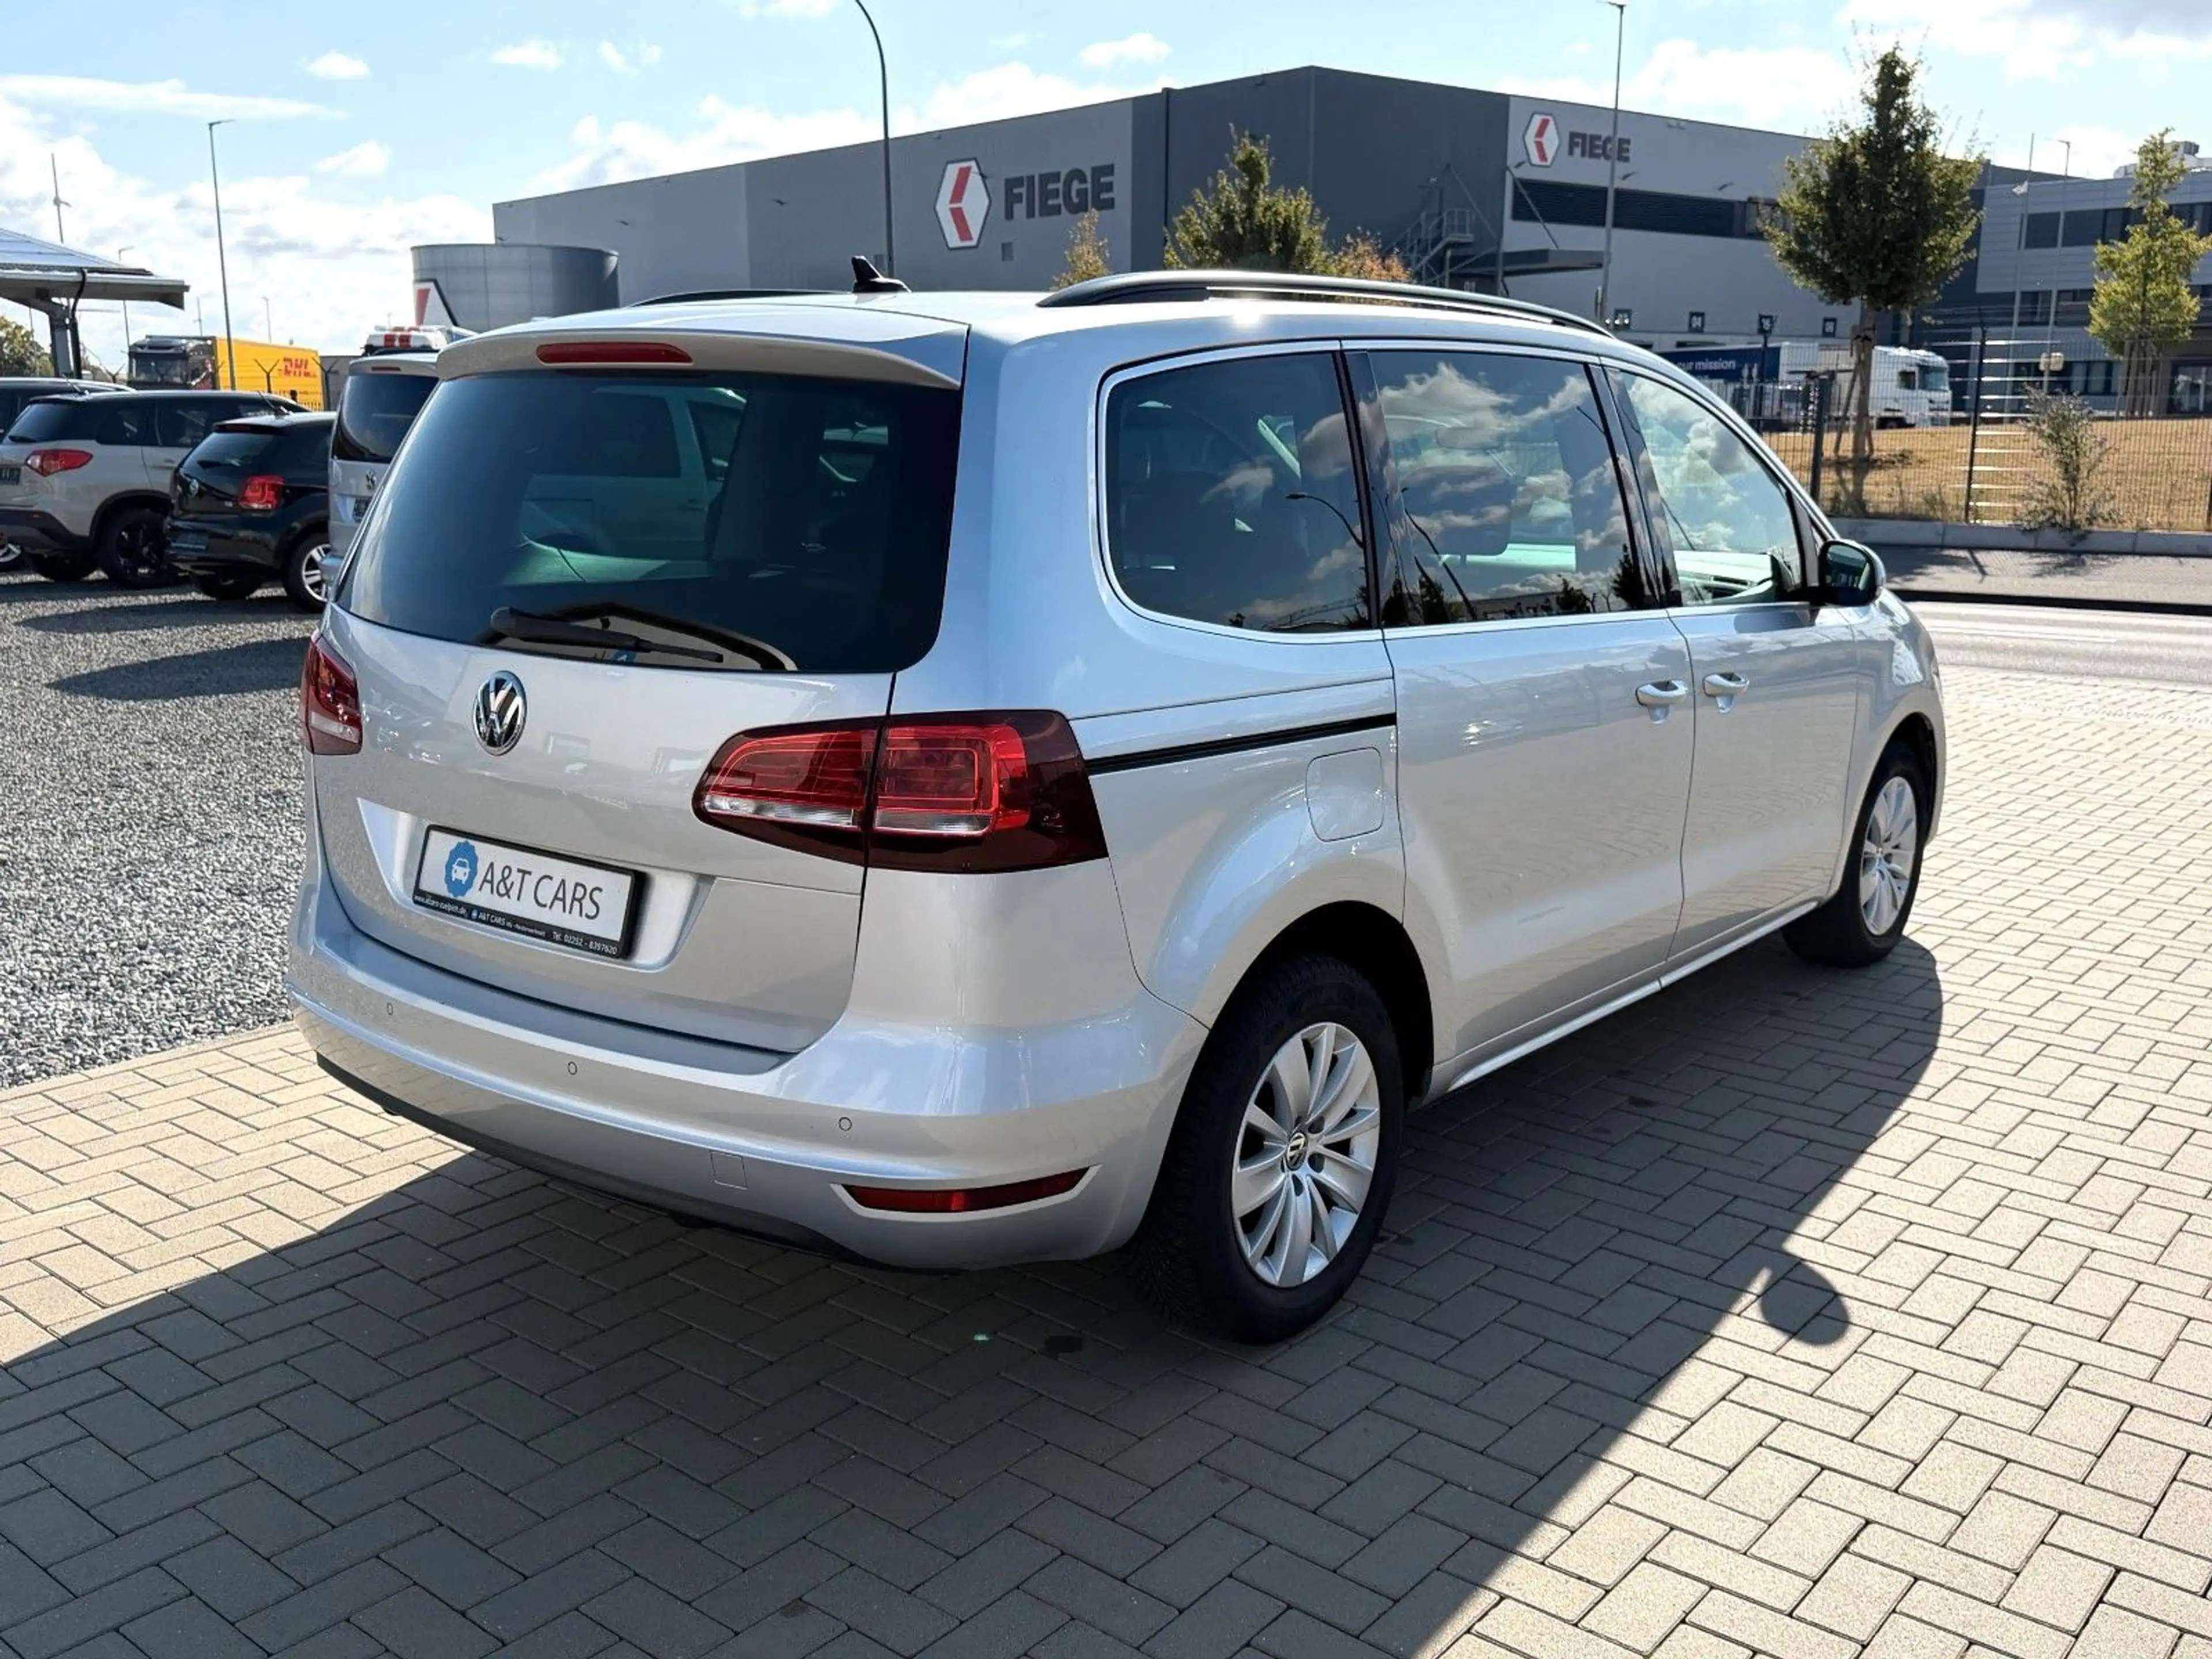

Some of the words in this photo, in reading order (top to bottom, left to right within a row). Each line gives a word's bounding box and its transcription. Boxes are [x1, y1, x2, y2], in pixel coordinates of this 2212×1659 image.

[1004, 163, 1115, 222] FIEGE
[1695, 357, 1736, 370] mission
[478, 861, 532, 902] A&T
[533, 874, 604, 921] CARS
